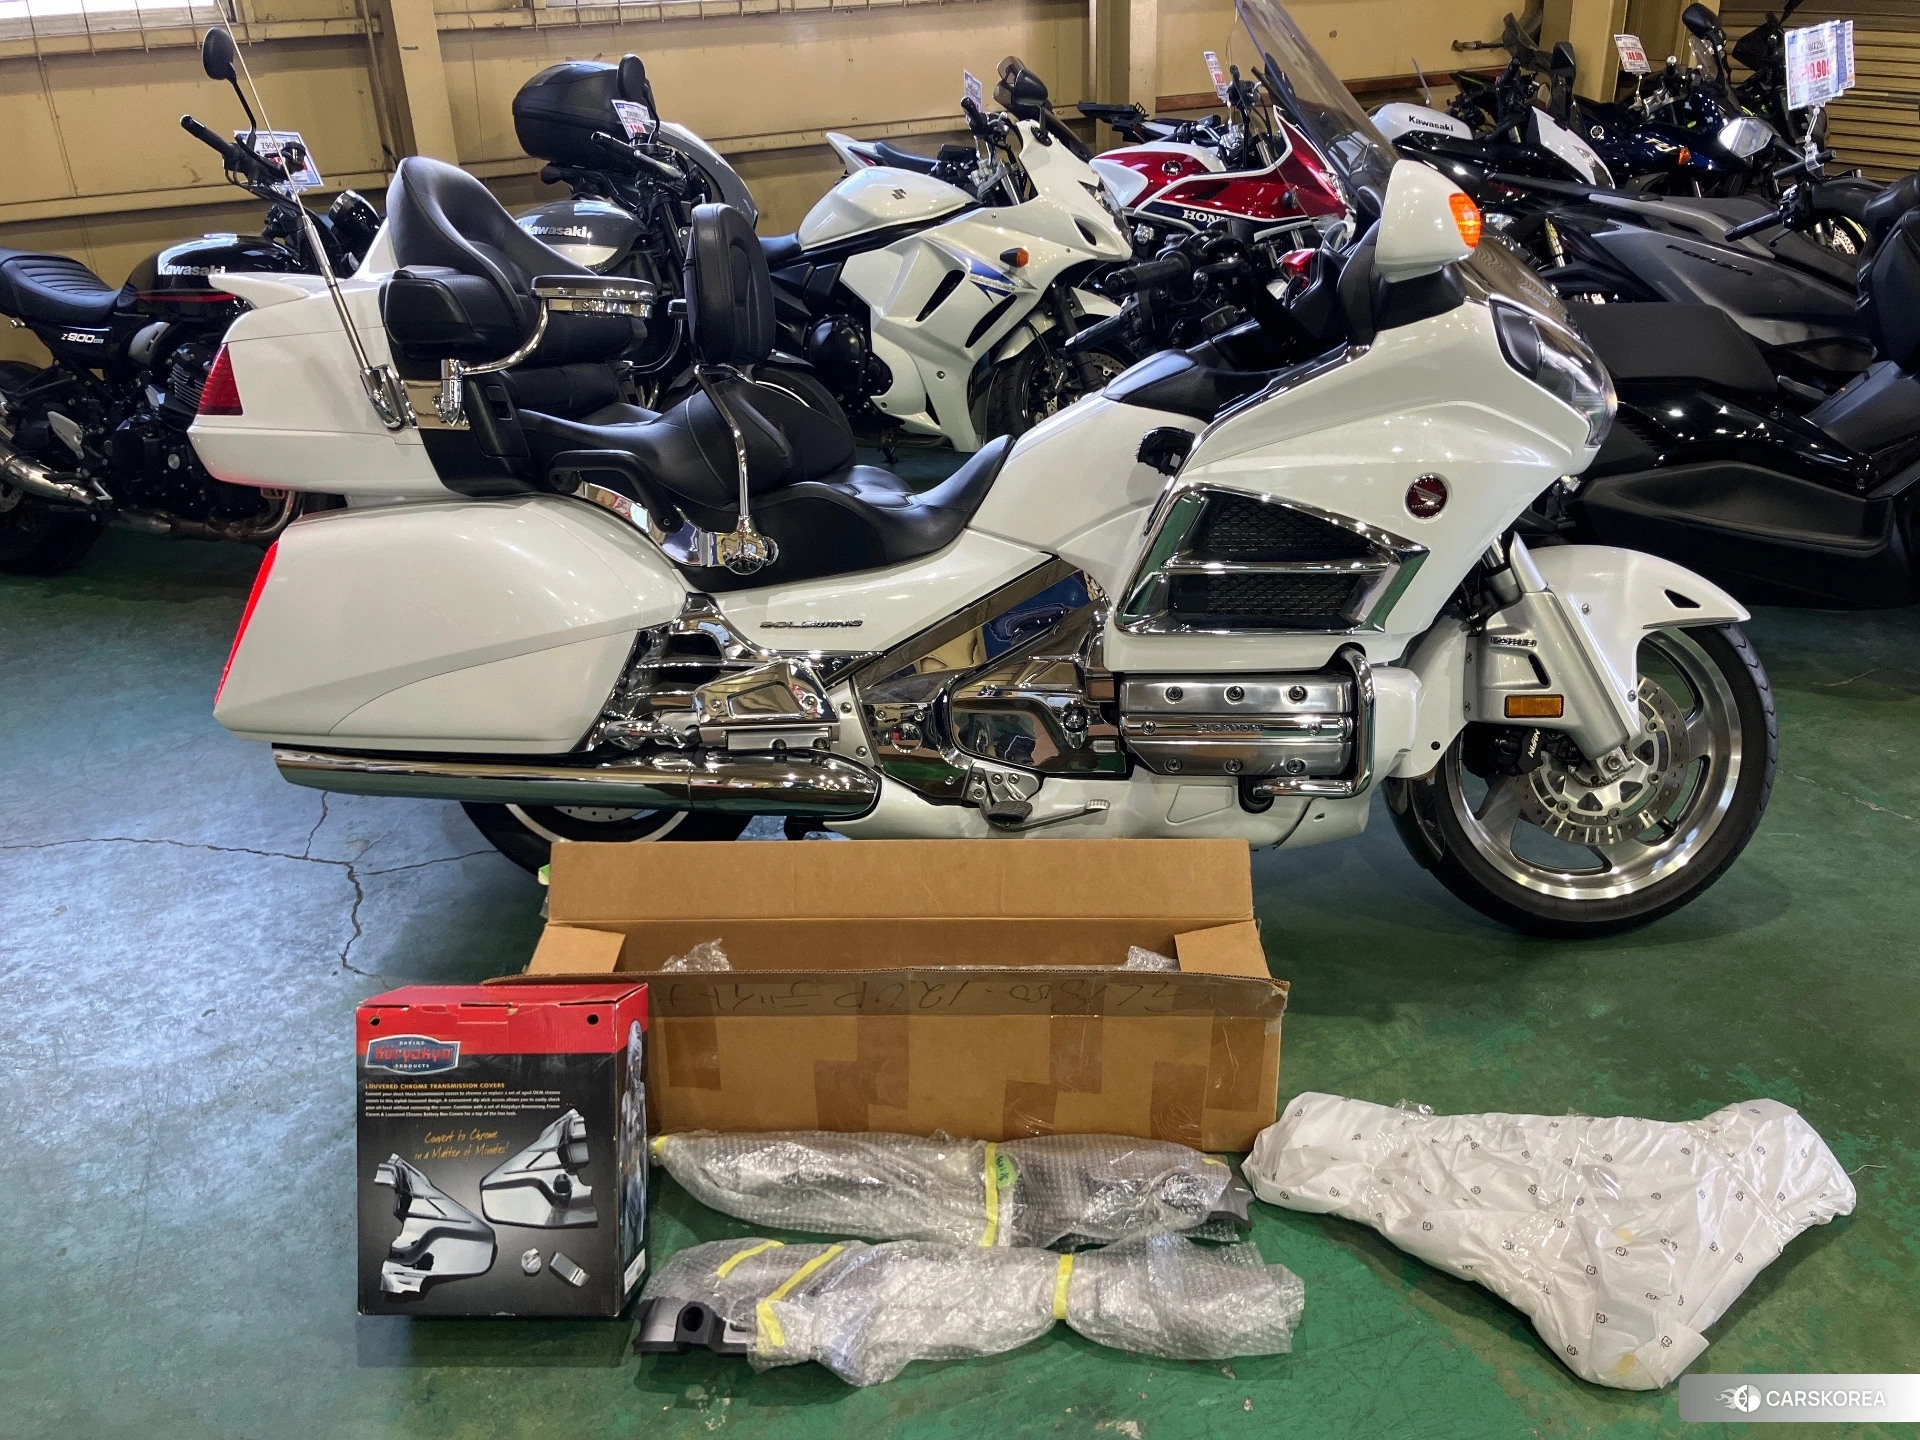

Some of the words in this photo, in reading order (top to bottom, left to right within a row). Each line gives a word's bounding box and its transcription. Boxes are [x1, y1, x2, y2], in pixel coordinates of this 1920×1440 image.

[1408, 115, 1454, 131] Kawasaki
[1182, 209, 1227, 223] HON
[523, 224, 589, 238] Kawasaki
[157, 262, 226, 276] Kawasaki
[1197, 723, 1264, 733] HONDA
[430, 1082, 478, 1090] TRANSMISSION
[424, 1130, 455, 1144] Convert
[458, 1129, 467, 1141] to
[469, 1128, 498, 1141] Chrome
[432, 1146, 461, 1159] Matter
[463, 1143, 472, 1162] of
